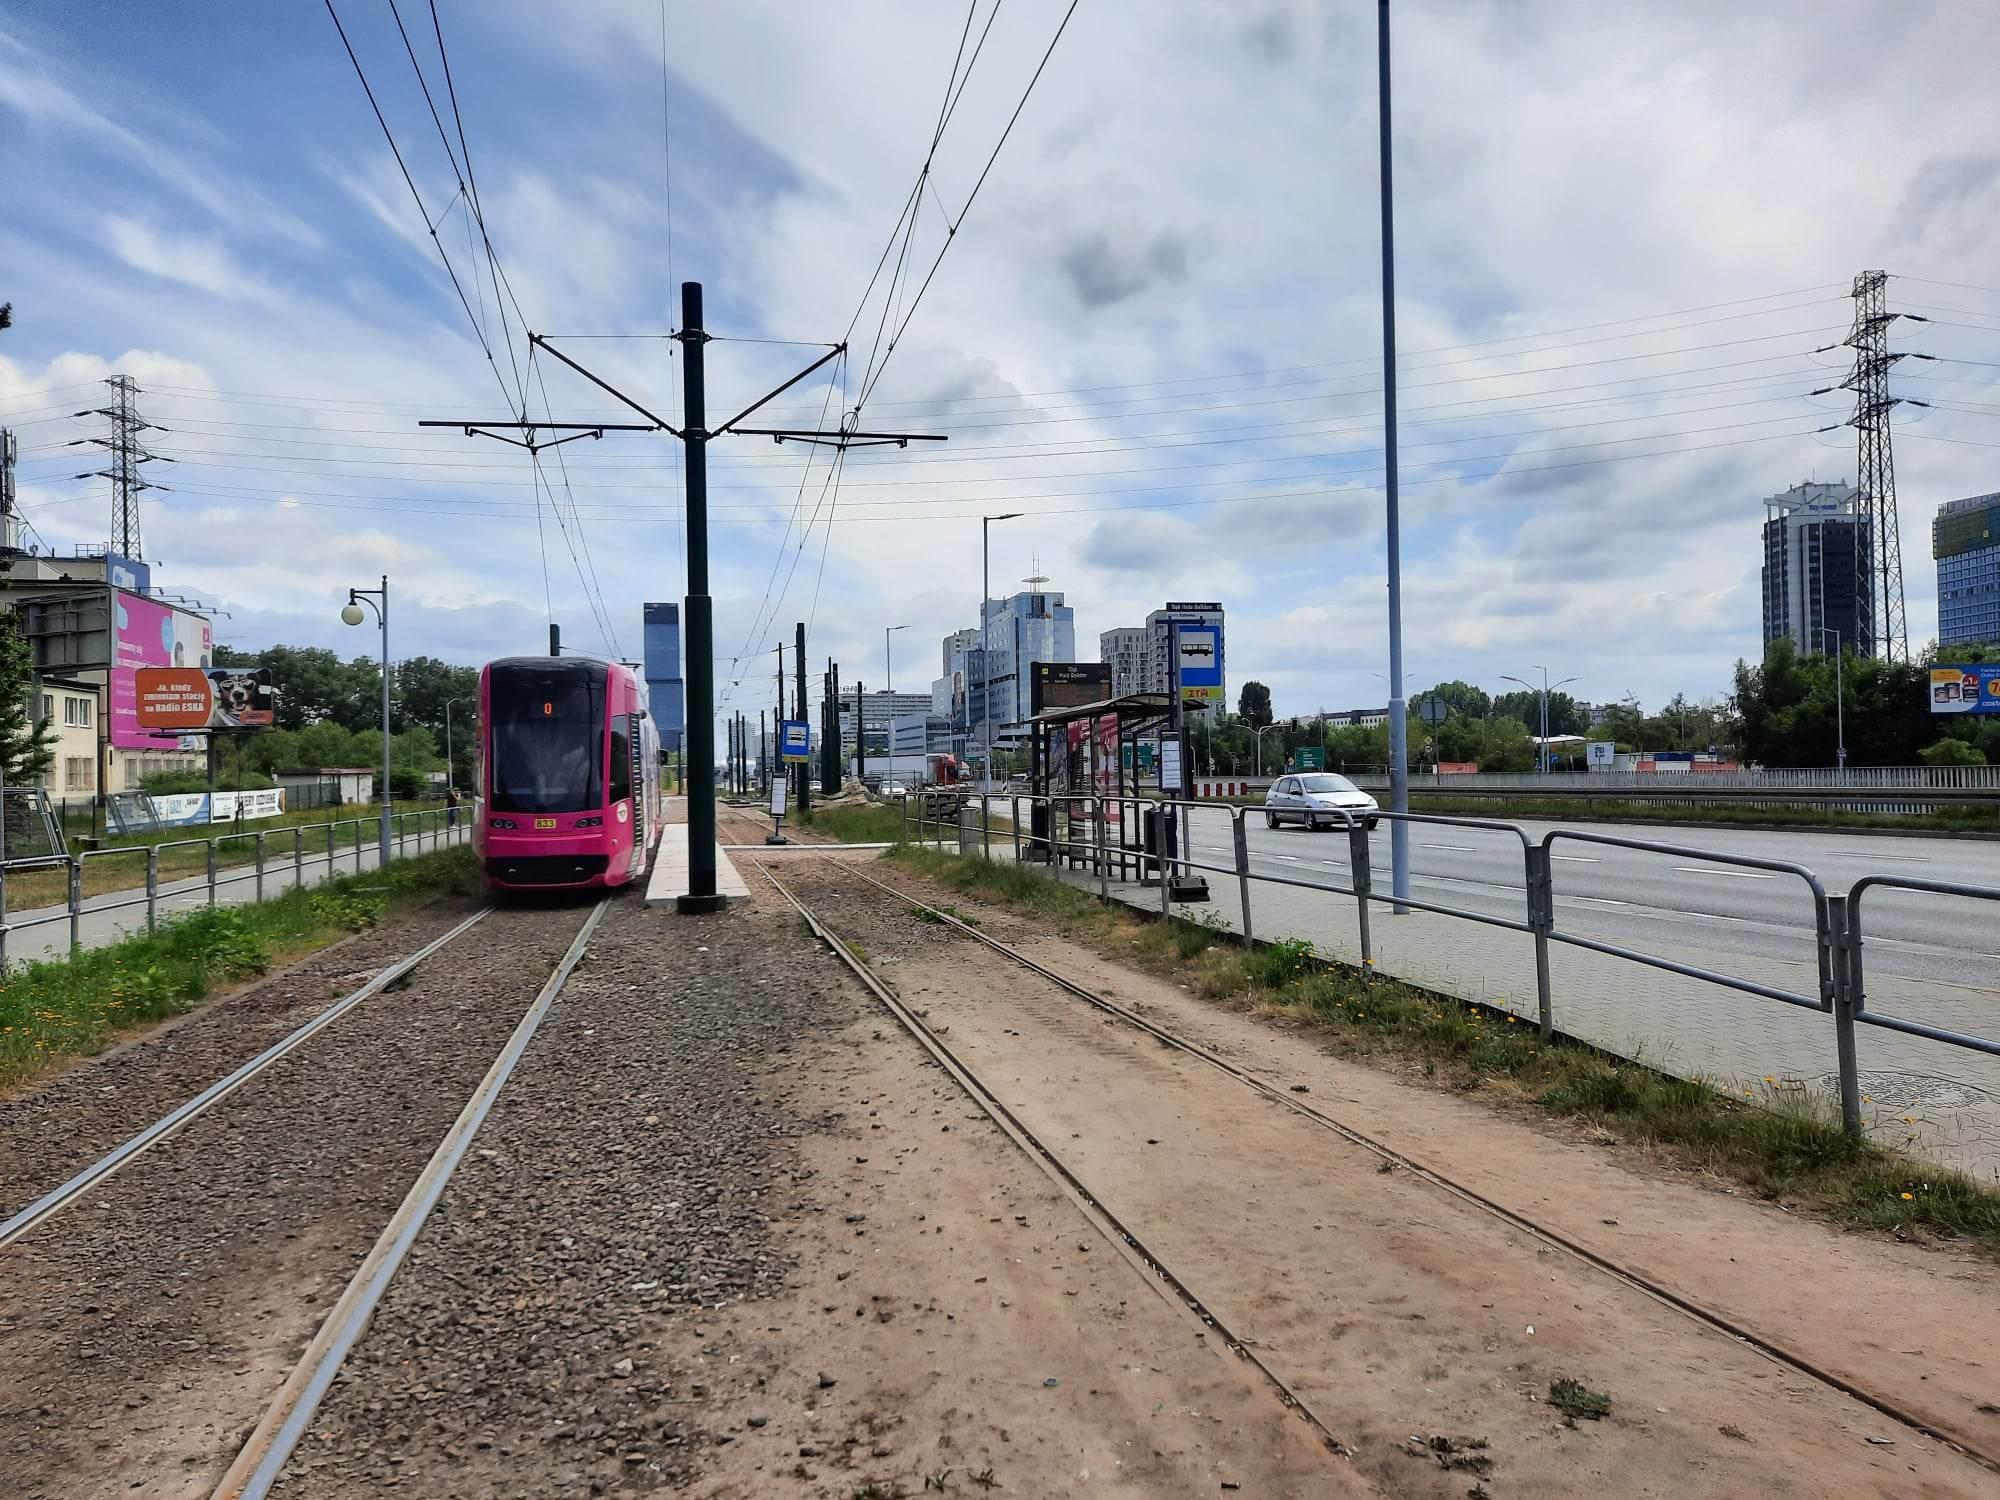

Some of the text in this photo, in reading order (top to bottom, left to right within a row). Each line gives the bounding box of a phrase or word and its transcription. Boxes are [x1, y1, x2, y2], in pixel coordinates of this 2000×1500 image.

[170, 684, 192, 692] kiedy
[143, 693, 180, 701] zmieniam
[155, 703, 181, 712] Radio
[182, 703, 204, 712] ESKA
[537, 819, 554, 828] 833
